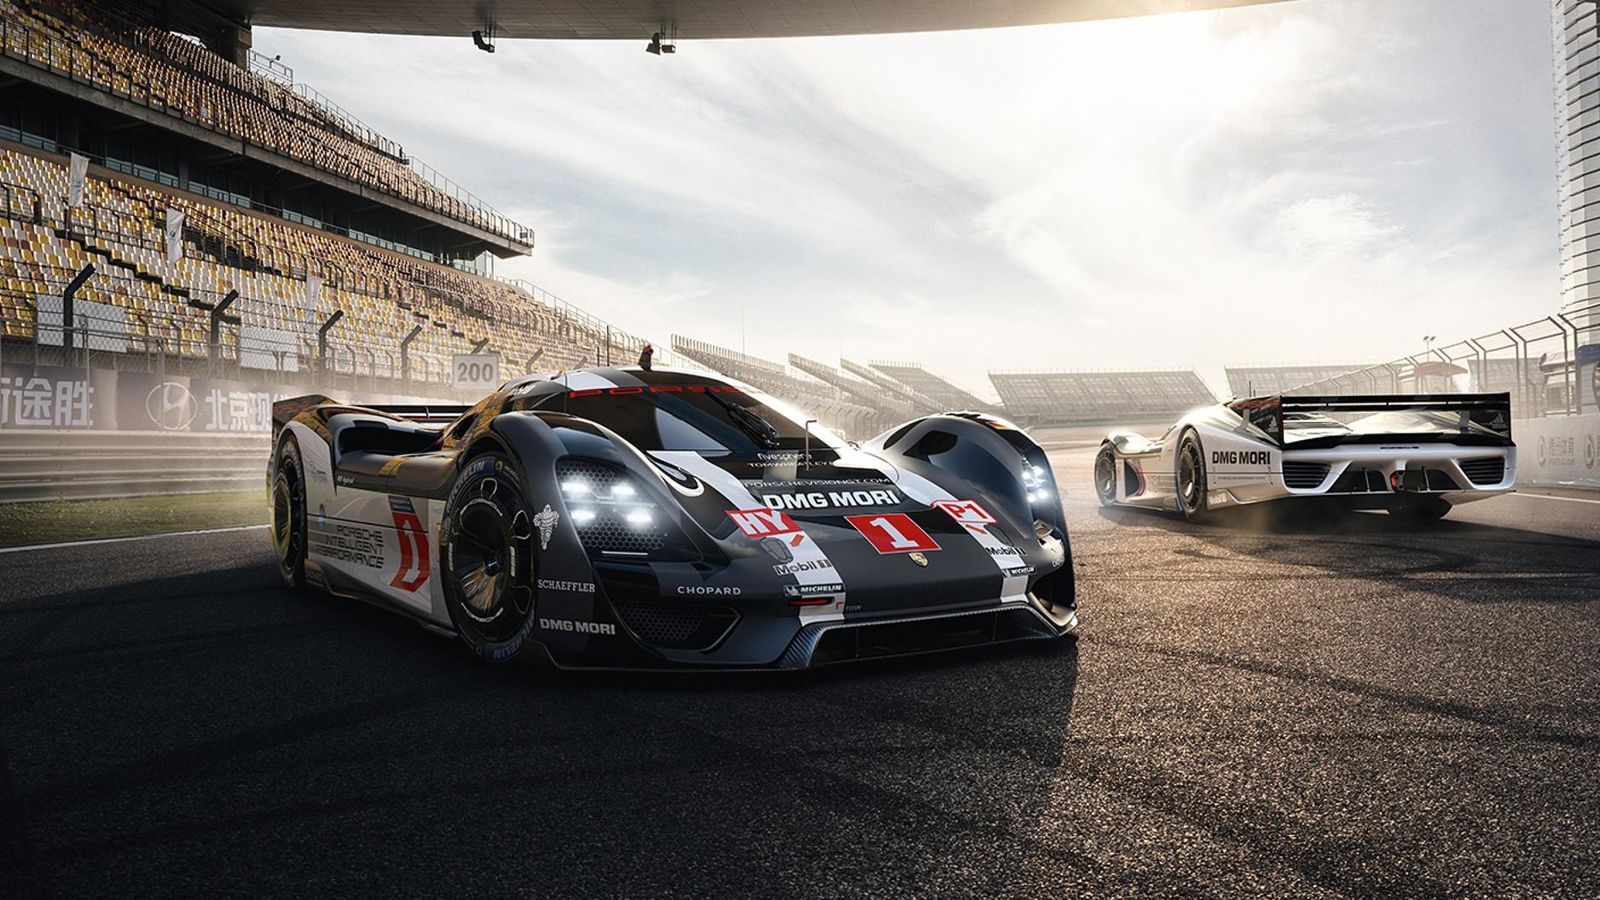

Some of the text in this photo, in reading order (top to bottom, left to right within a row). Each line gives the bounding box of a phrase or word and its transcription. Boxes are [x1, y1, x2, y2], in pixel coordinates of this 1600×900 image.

[457, 362, 494, 382] 200
[205, 389, 288, 431] 北京现
[1212, 451, 1270, 465] DMG MORI
[763, 490, 900, 510] DMG MORI
[942, 503, 988, 519] P1
[732, 511, 788, 535] HY
[337, 525, 382, 542] PORSCHE
[870, 517, 919, 549] 1
[985, 547, 1018, 555] Mobil
[776, 561, 817, 574] Mobil
[537, 580, 596, 593] SCHAEFFLER
[677, 586, 741, 596] CHOPARD
[540, 618, 616, 635] DMG MORI
